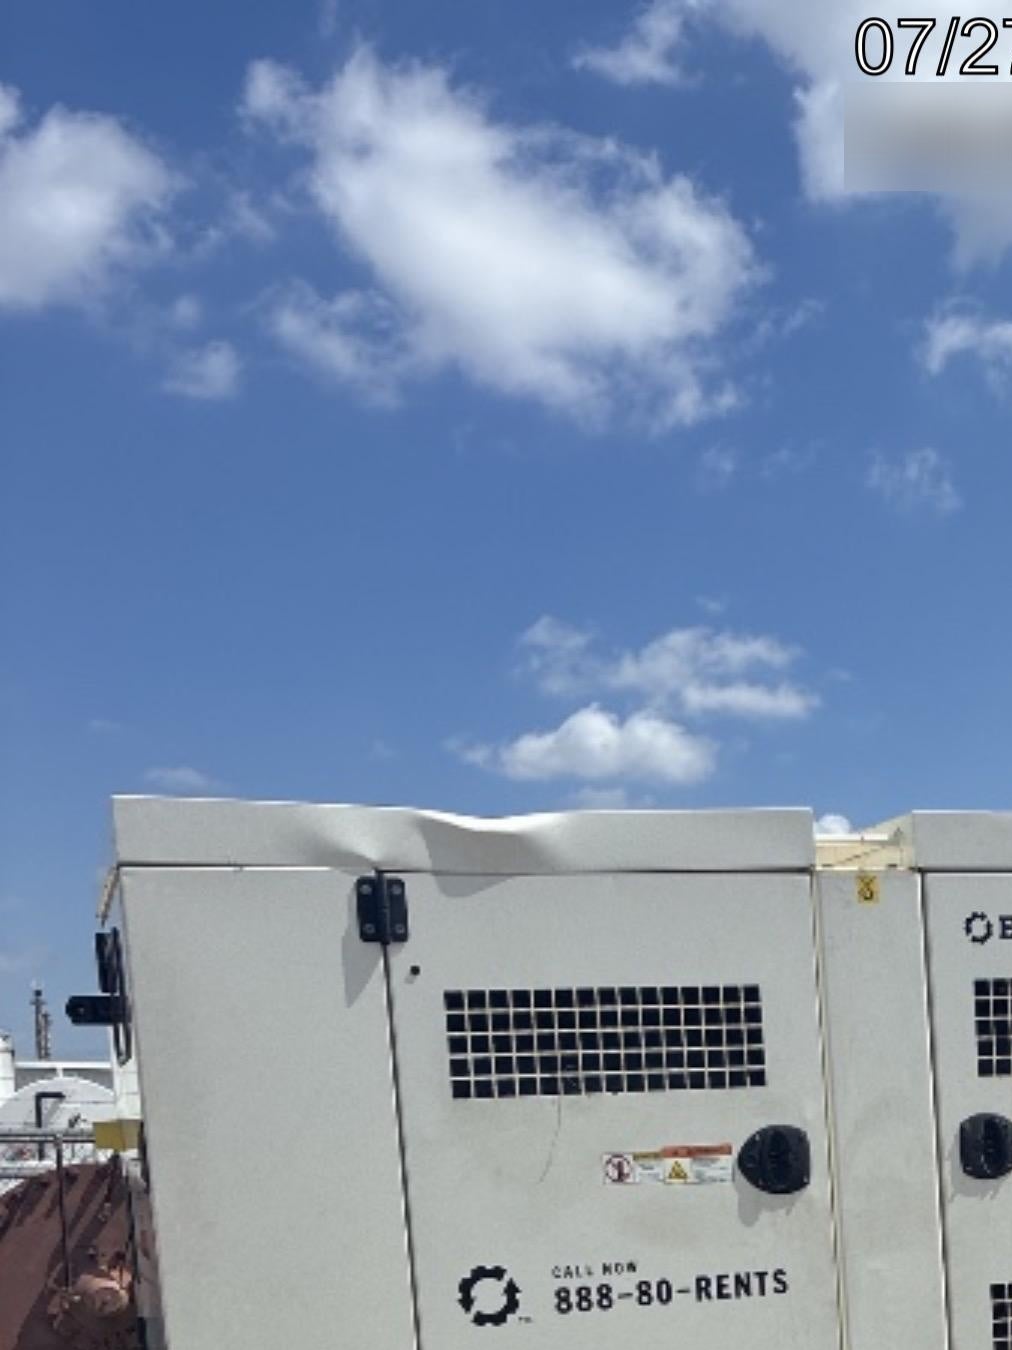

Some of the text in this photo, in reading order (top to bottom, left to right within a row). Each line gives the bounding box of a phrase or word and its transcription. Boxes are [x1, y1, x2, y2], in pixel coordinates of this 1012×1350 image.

[551, 1260, 637, 1279] CALL NOW
[554, 1268, 788, 1315] 888-80-RENTS
